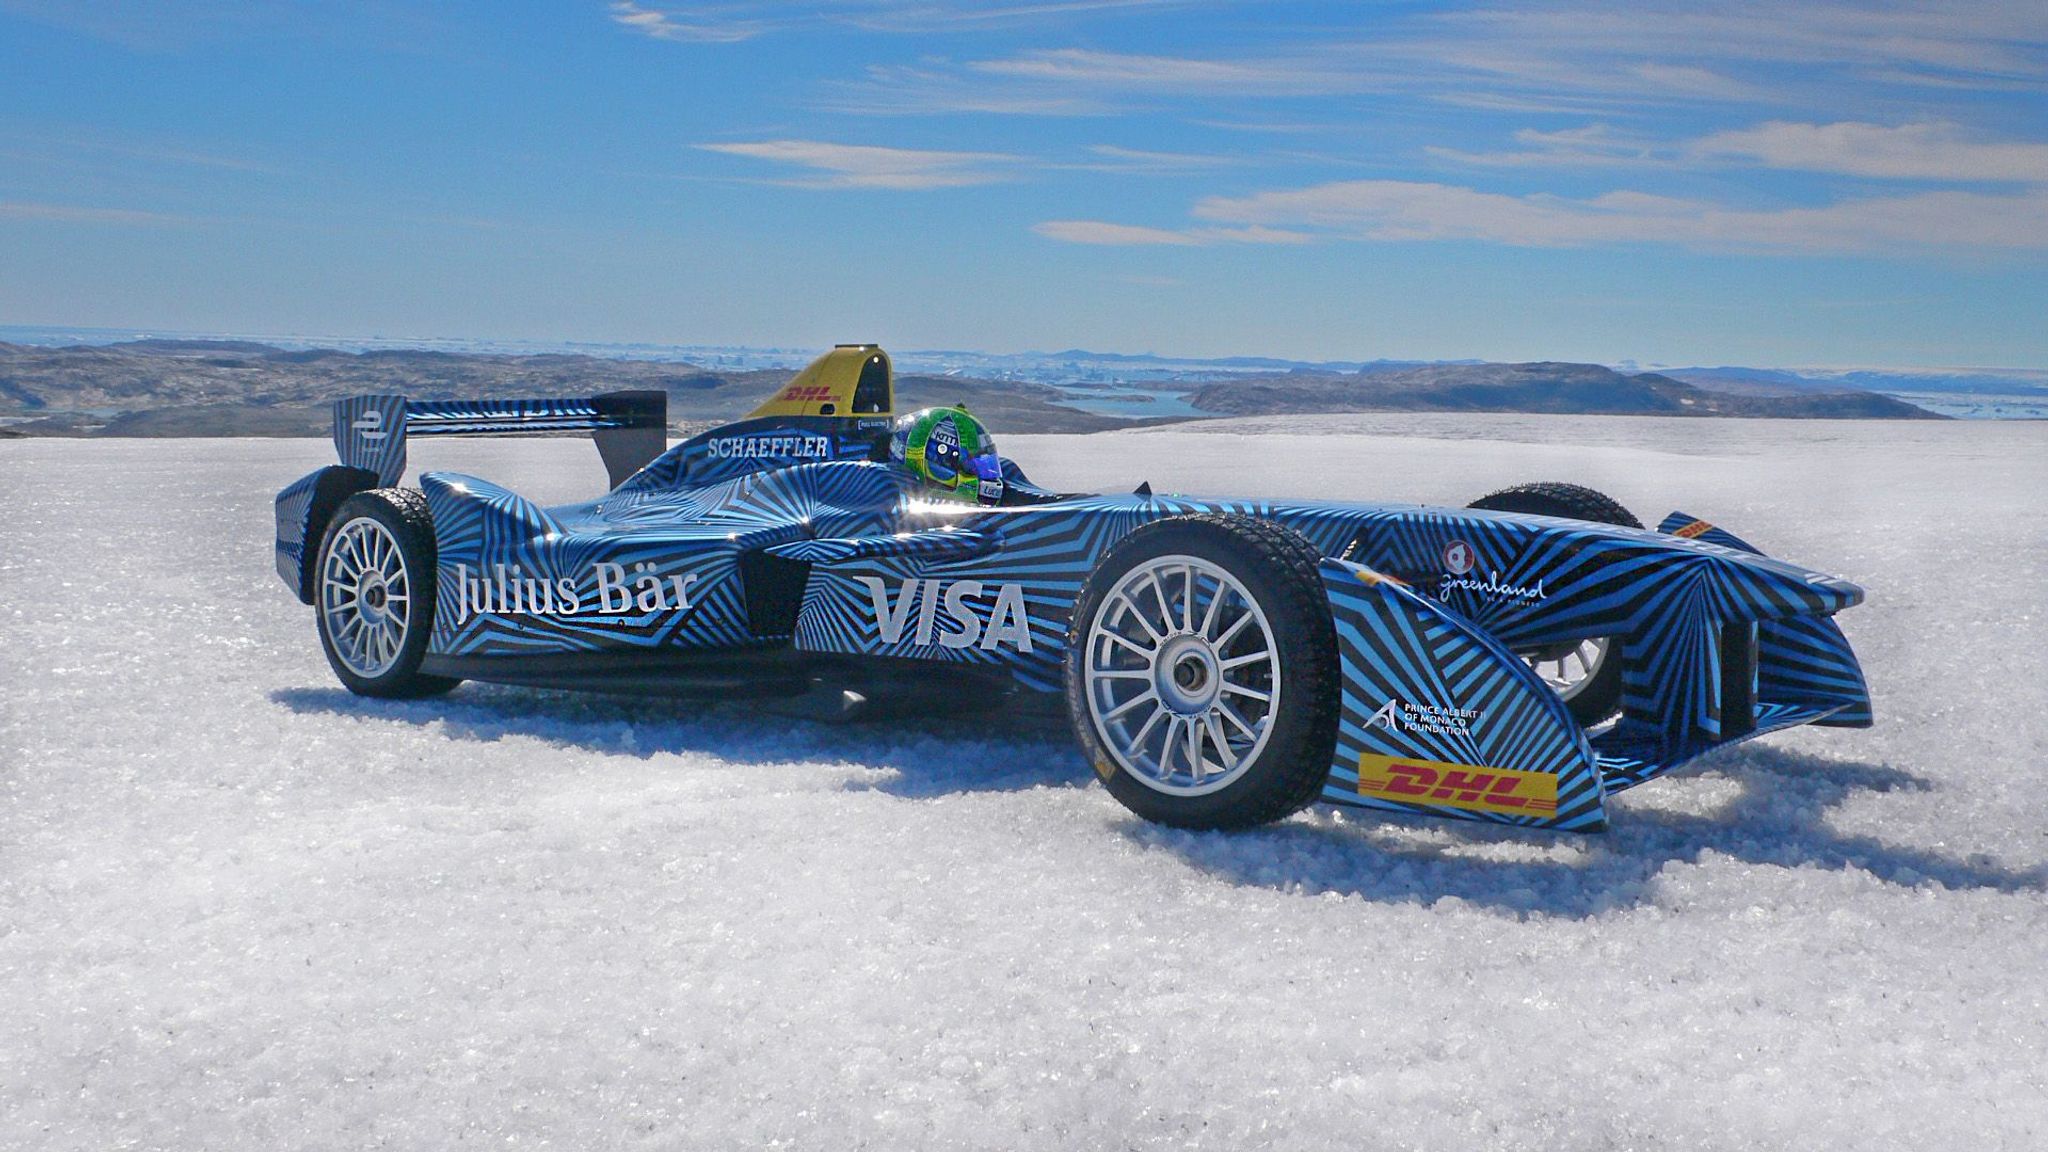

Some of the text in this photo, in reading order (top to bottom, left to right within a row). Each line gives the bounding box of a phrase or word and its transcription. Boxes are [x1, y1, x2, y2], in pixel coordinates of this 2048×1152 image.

[783, 386, 832, 400] DHL
[707, 436, 828, 458] SCHAEFFLER
[457, 562, 698, 625] Julius Bär
[1440, 571, 1547, 602] greenland
[852, 576, 1034, 653] VISA
[1404, 703, 1439, 715] PRINCE
[1443, 707, 1478, 719] ALBERT
[1404, 713, 1466, 727] OF MONACO
[1404, 721, 1470, 736] FOUNDATION
[1383, 763, 1528, 808] DHL
